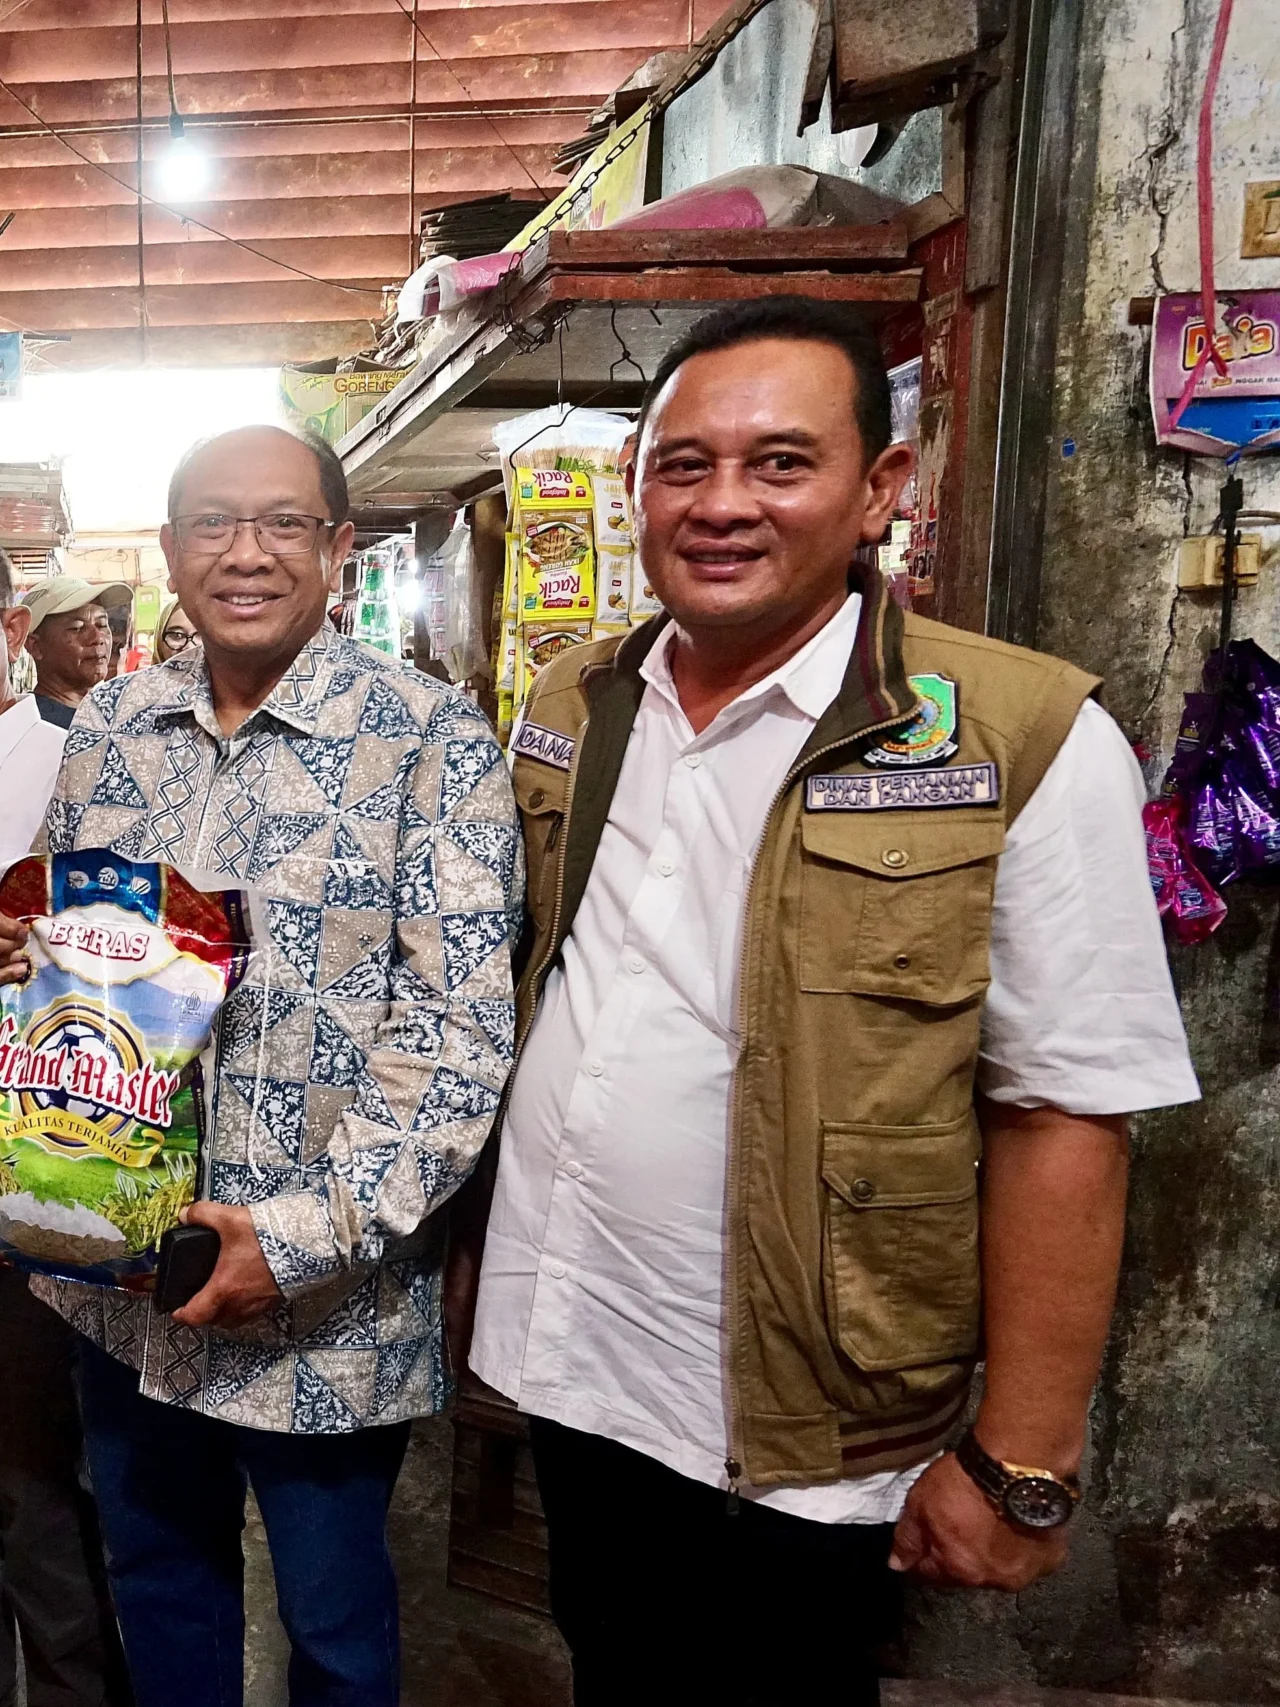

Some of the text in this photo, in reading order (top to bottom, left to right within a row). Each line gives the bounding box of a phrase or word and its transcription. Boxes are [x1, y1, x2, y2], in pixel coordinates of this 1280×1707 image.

[539, 575, 581, 598] Racik
[813, 768, 986, 793] DINAS PERTANIAN
[824, 782, 976, 806] DAN PANGAN
[48, 920, 151, 962] BERAS
[69, 1046, 182, 1128] Master
[4, 1116, 133, 1163] KUALITAS TERJAMIN
